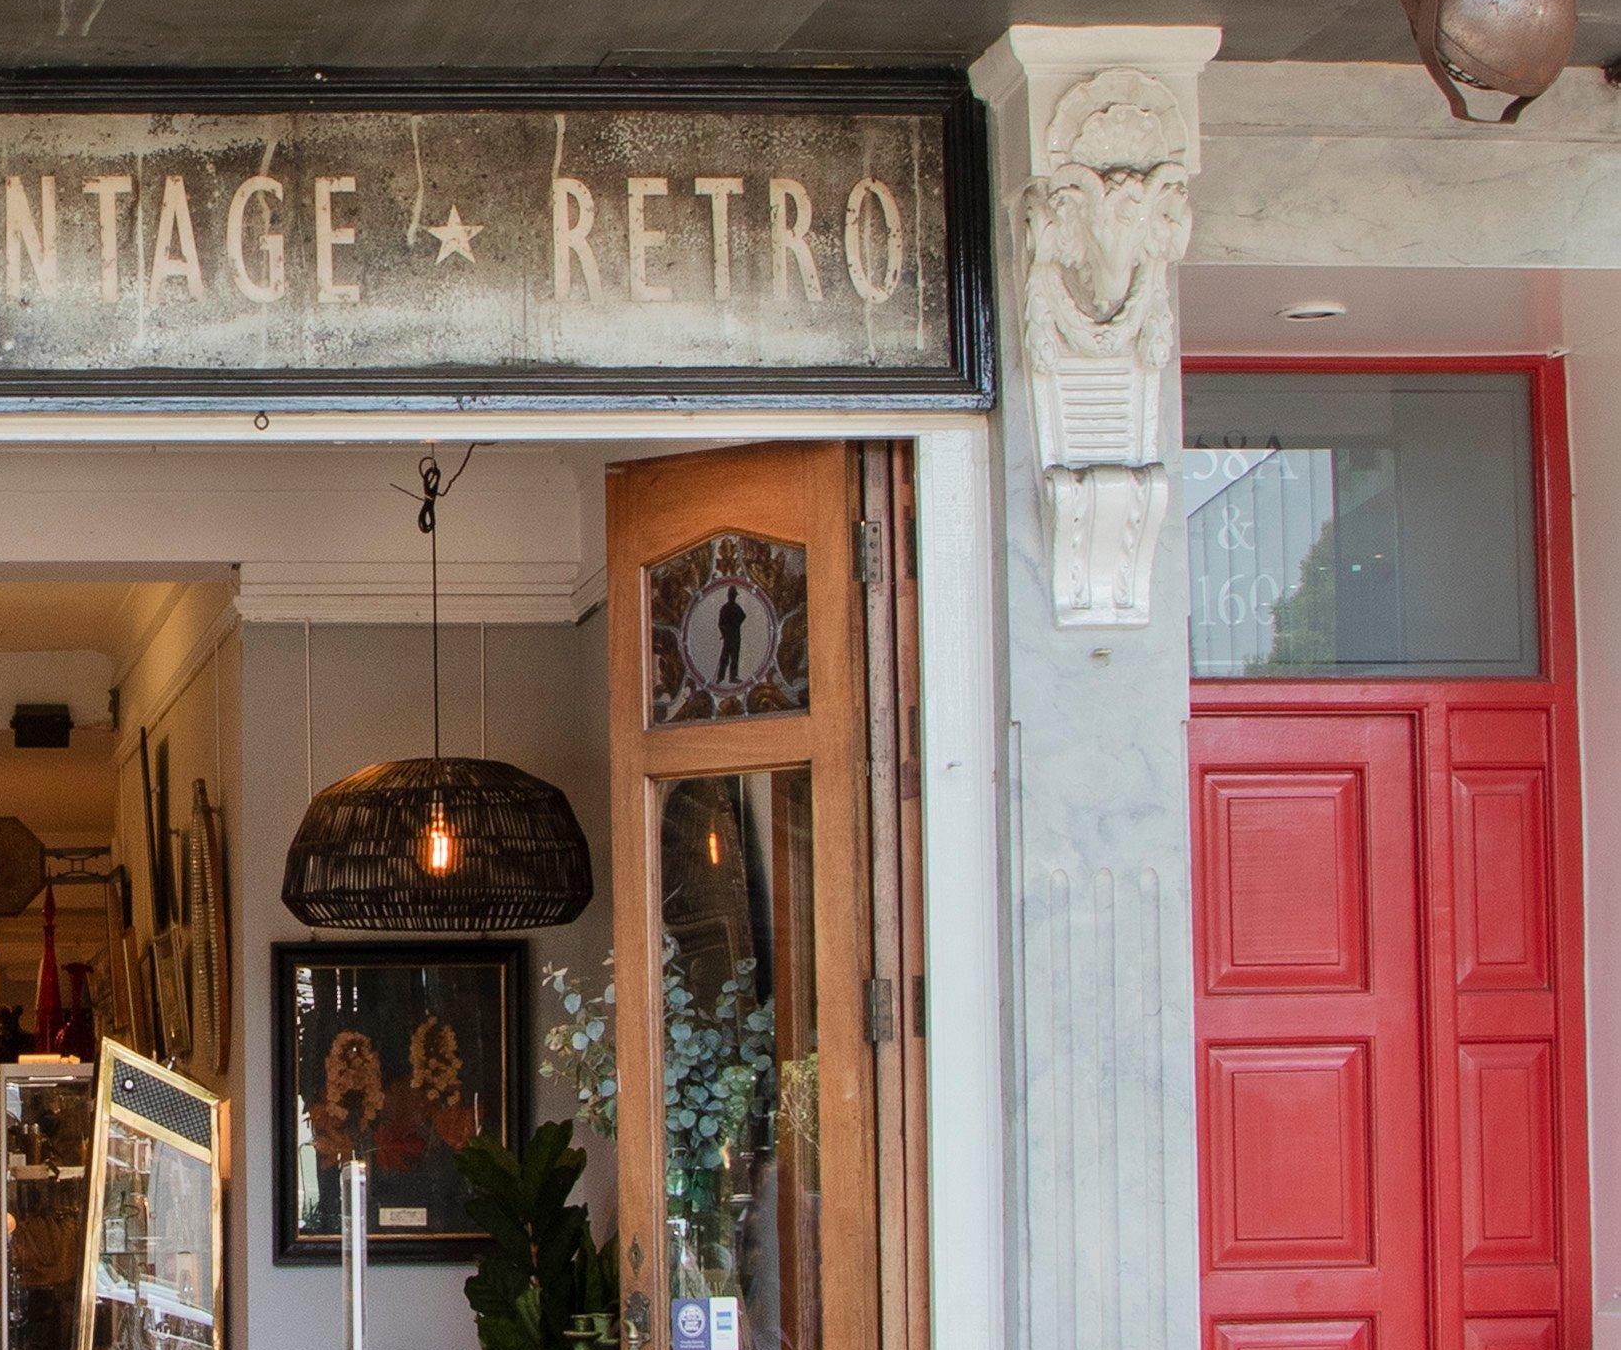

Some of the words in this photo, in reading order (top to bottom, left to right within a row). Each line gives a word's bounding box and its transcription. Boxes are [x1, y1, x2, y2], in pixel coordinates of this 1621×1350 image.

[550, 175, 903, 305] RETRO
[1183, 429, 1299, 481] 58A
[1217, 504, 1256, 550] &
[1197, 573, 1279, 626] 160
